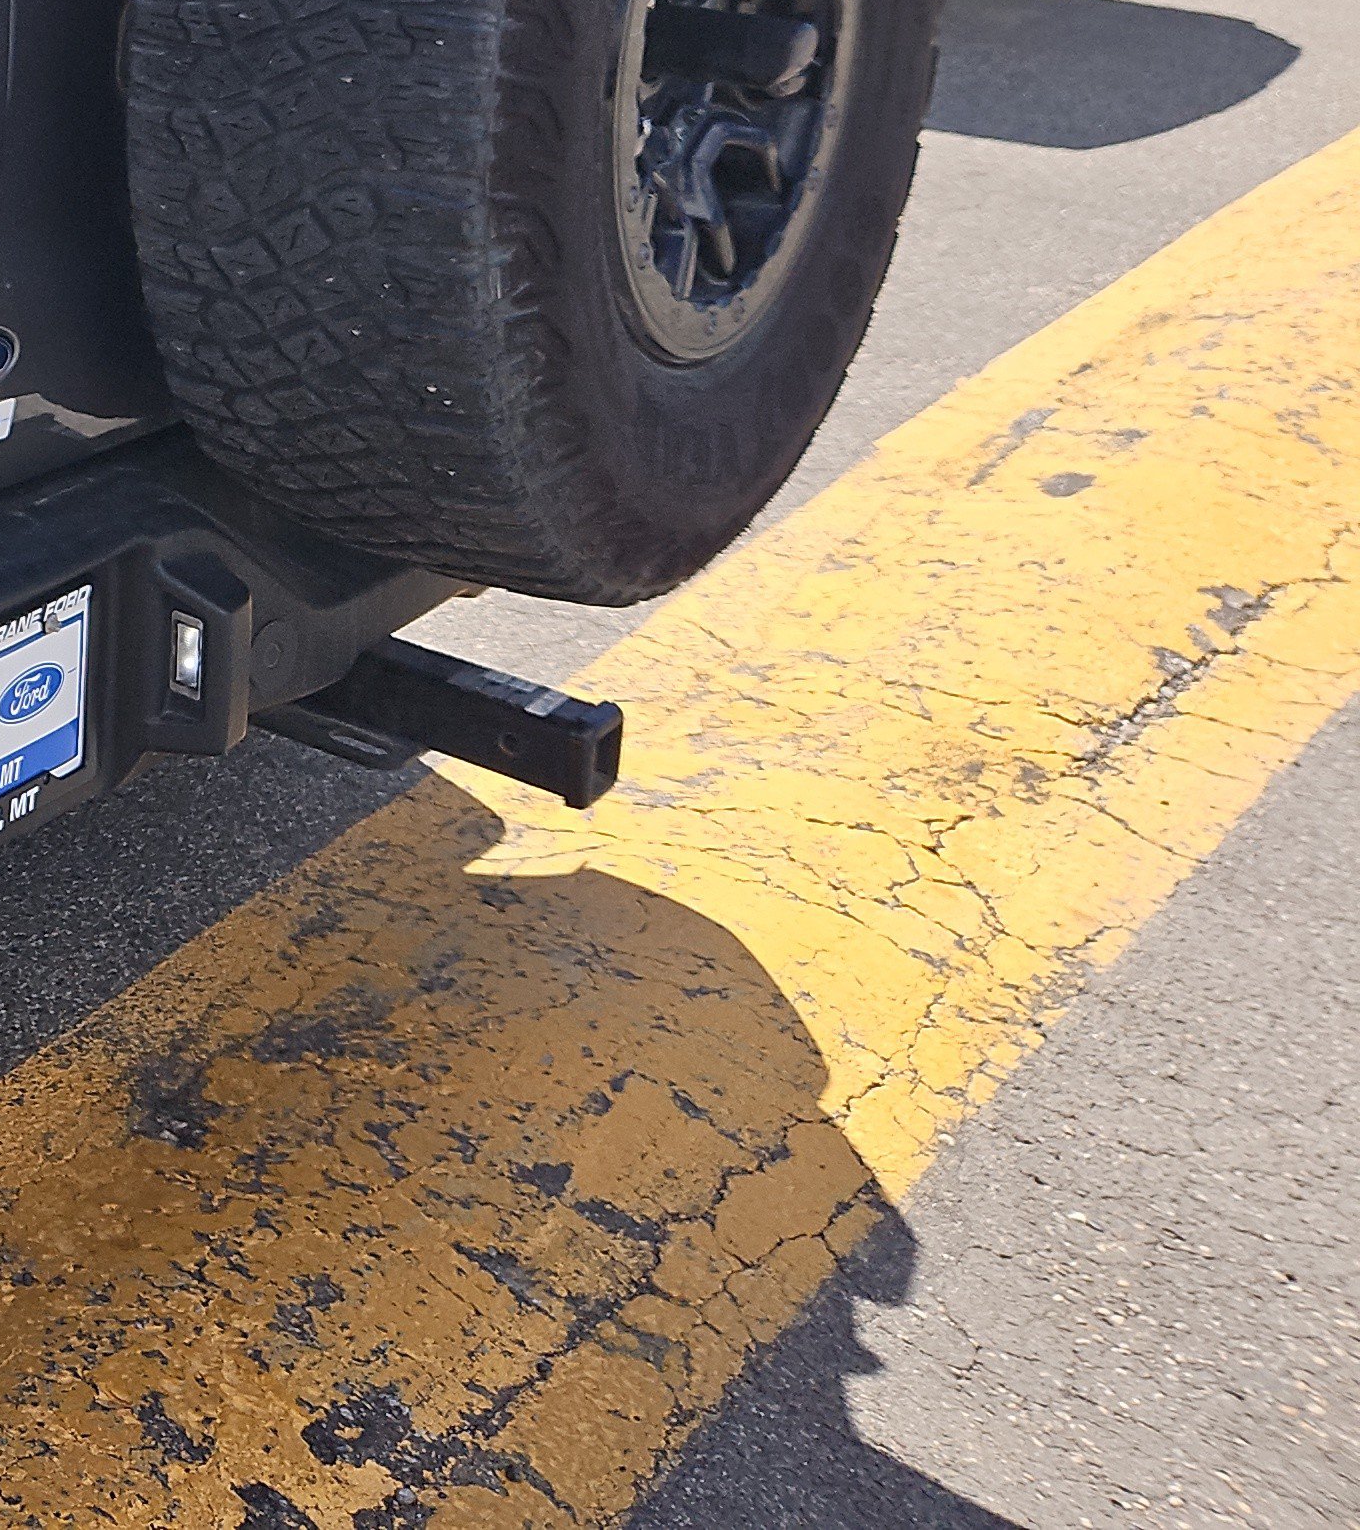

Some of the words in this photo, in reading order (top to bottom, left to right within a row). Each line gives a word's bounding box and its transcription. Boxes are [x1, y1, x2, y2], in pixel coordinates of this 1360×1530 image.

[44, 585, 90, 623] FORD
[10, 672, 51, 716] Ford
[0, 755, 24, 788] MT
[9, 785, 40, 822] MT
